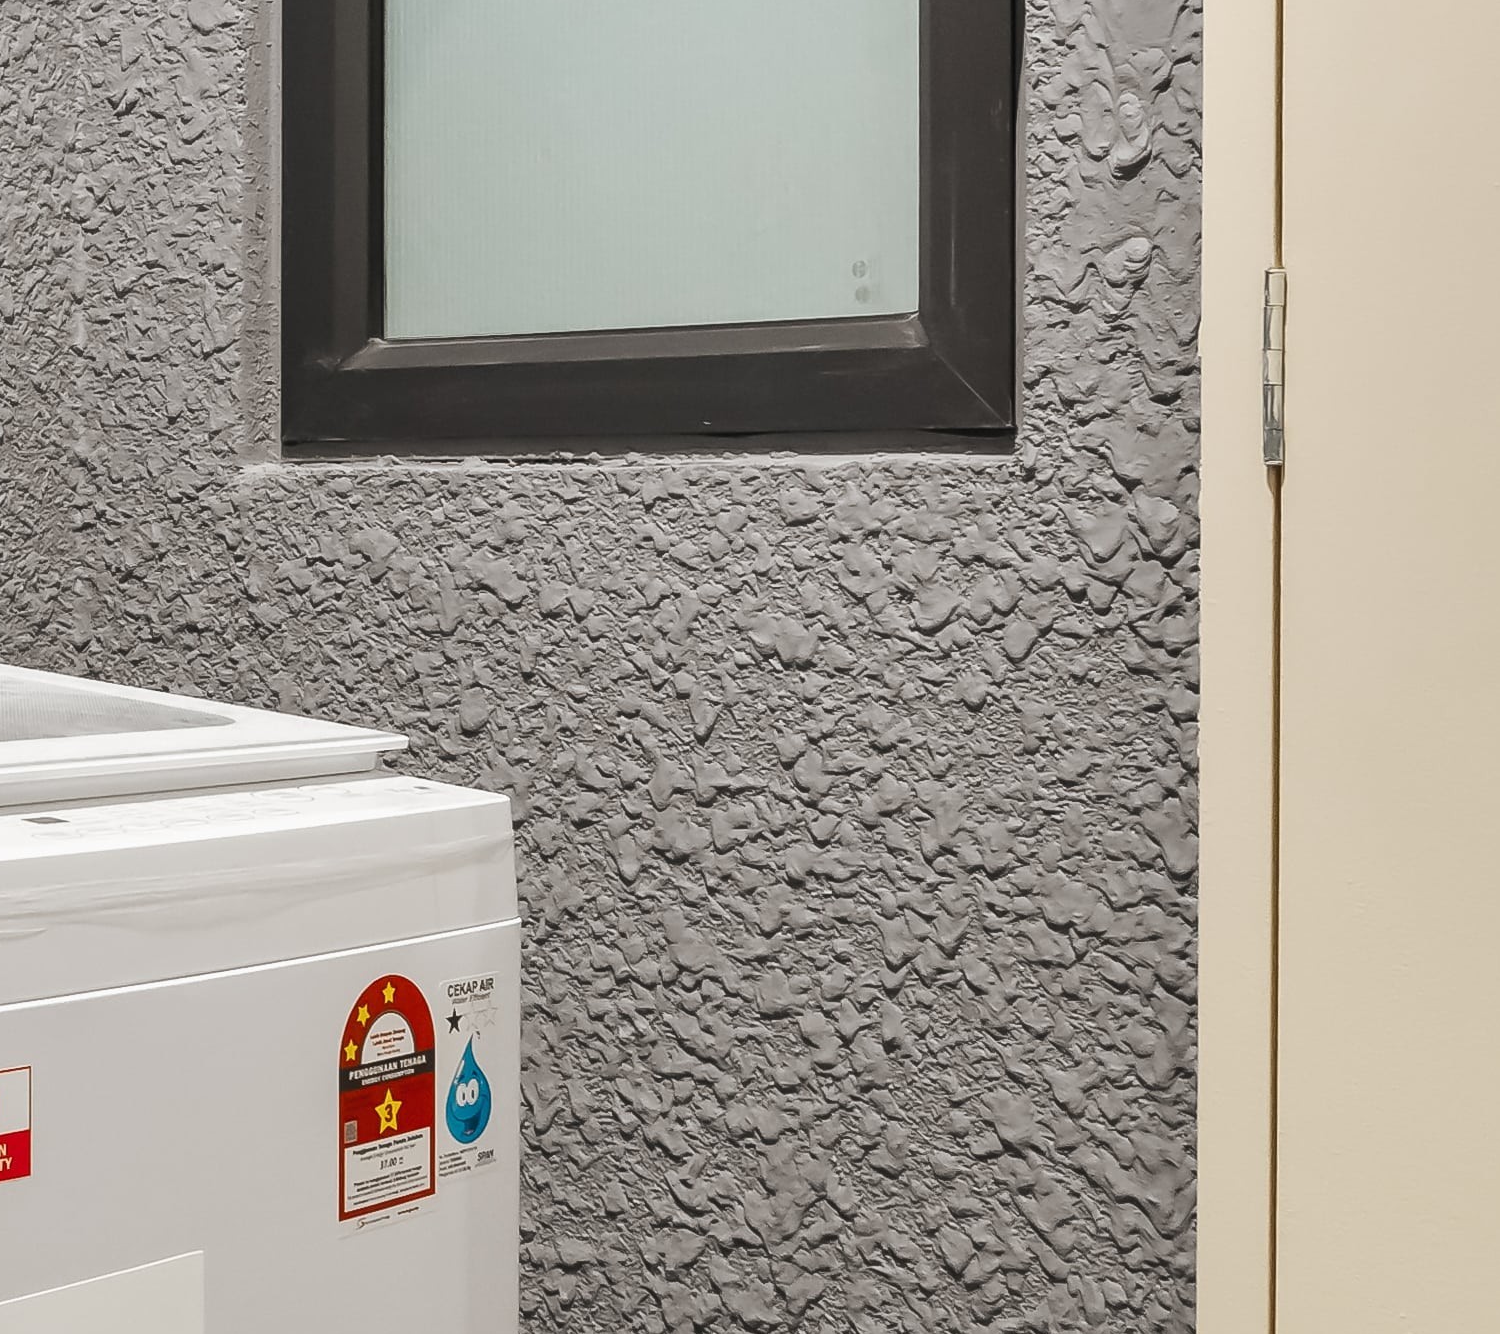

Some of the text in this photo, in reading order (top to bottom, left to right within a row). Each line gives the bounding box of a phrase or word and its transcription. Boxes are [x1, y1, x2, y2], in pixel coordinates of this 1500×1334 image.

[448, 978, 494, 998] CEKAP AIR
[400, 1055, 427, 1069] TENAGA
[384, 1103, 393, 1124] 3
